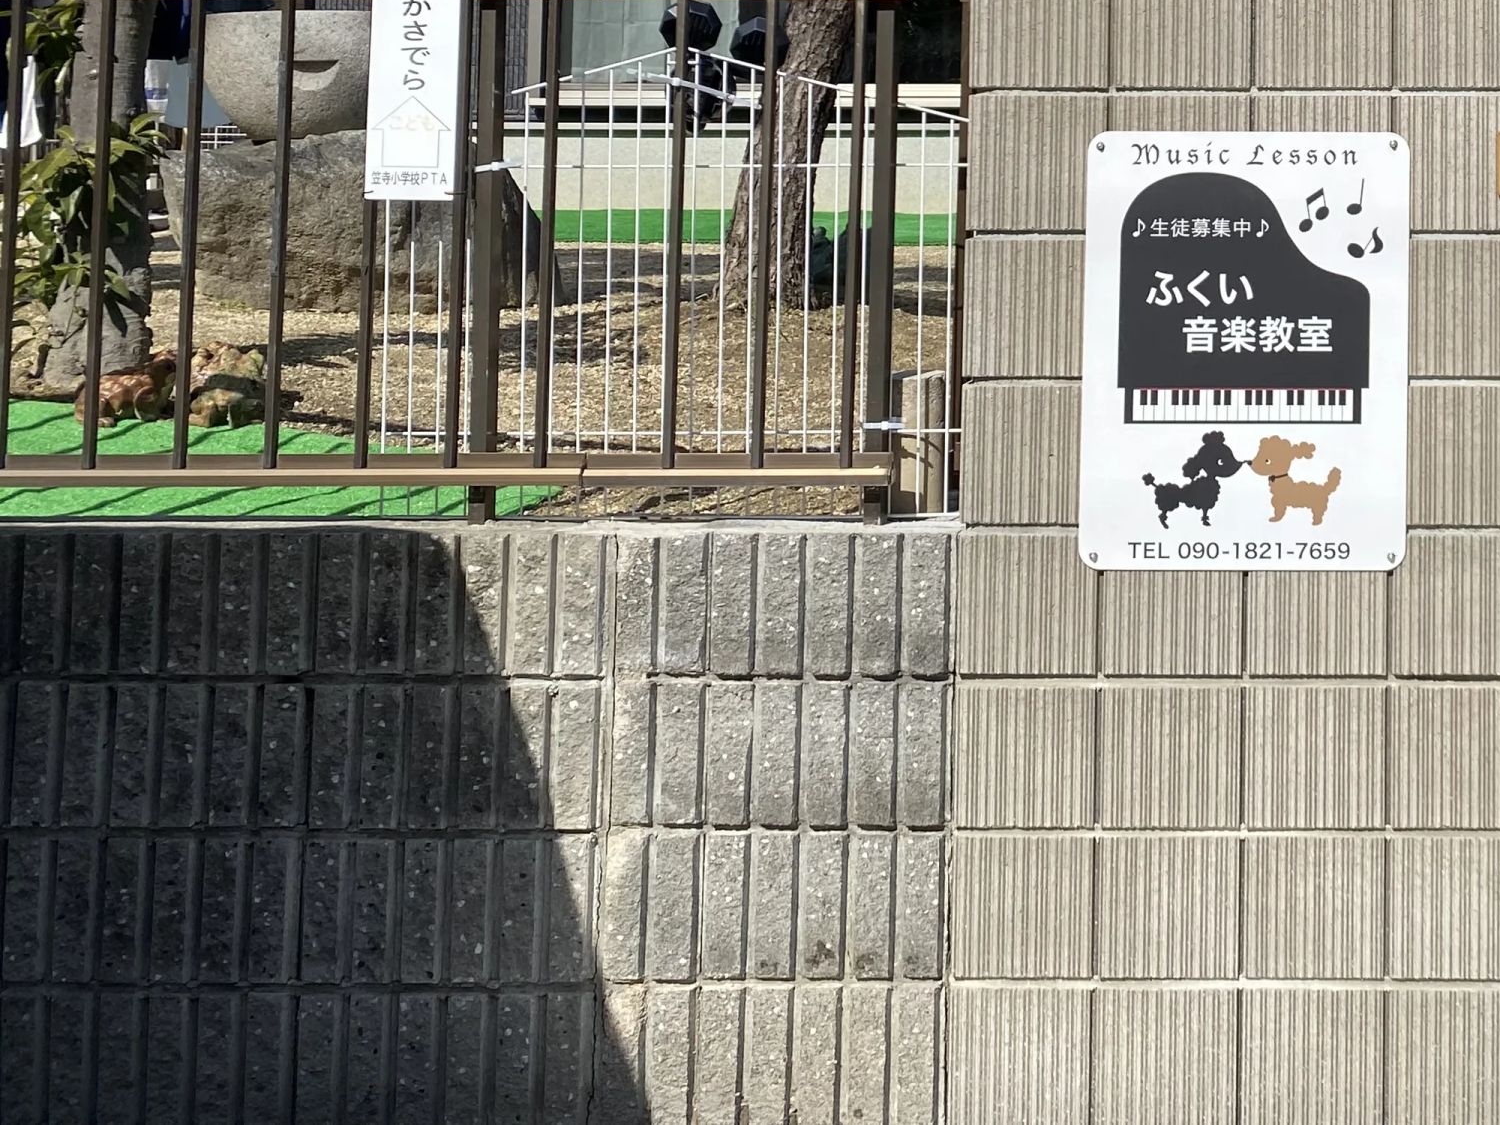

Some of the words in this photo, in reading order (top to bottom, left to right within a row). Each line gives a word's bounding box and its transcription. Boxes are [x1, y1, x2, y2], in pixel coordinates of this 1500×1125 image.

[388, 115, 436, 132] こども
[1132, 141, 1231, 166] Music
[1246, 142, 1360, 166] Lesson
[371, 171, 447, 186] 笠寺小学校PTA
[1145, 269, 1254, 307] ふくい
[1182, 316, 1333, 353] 音楽教室
[1128, 542, 1170, 559] TEL
[1178, 542, 1351, 560] 090-1821-7659
